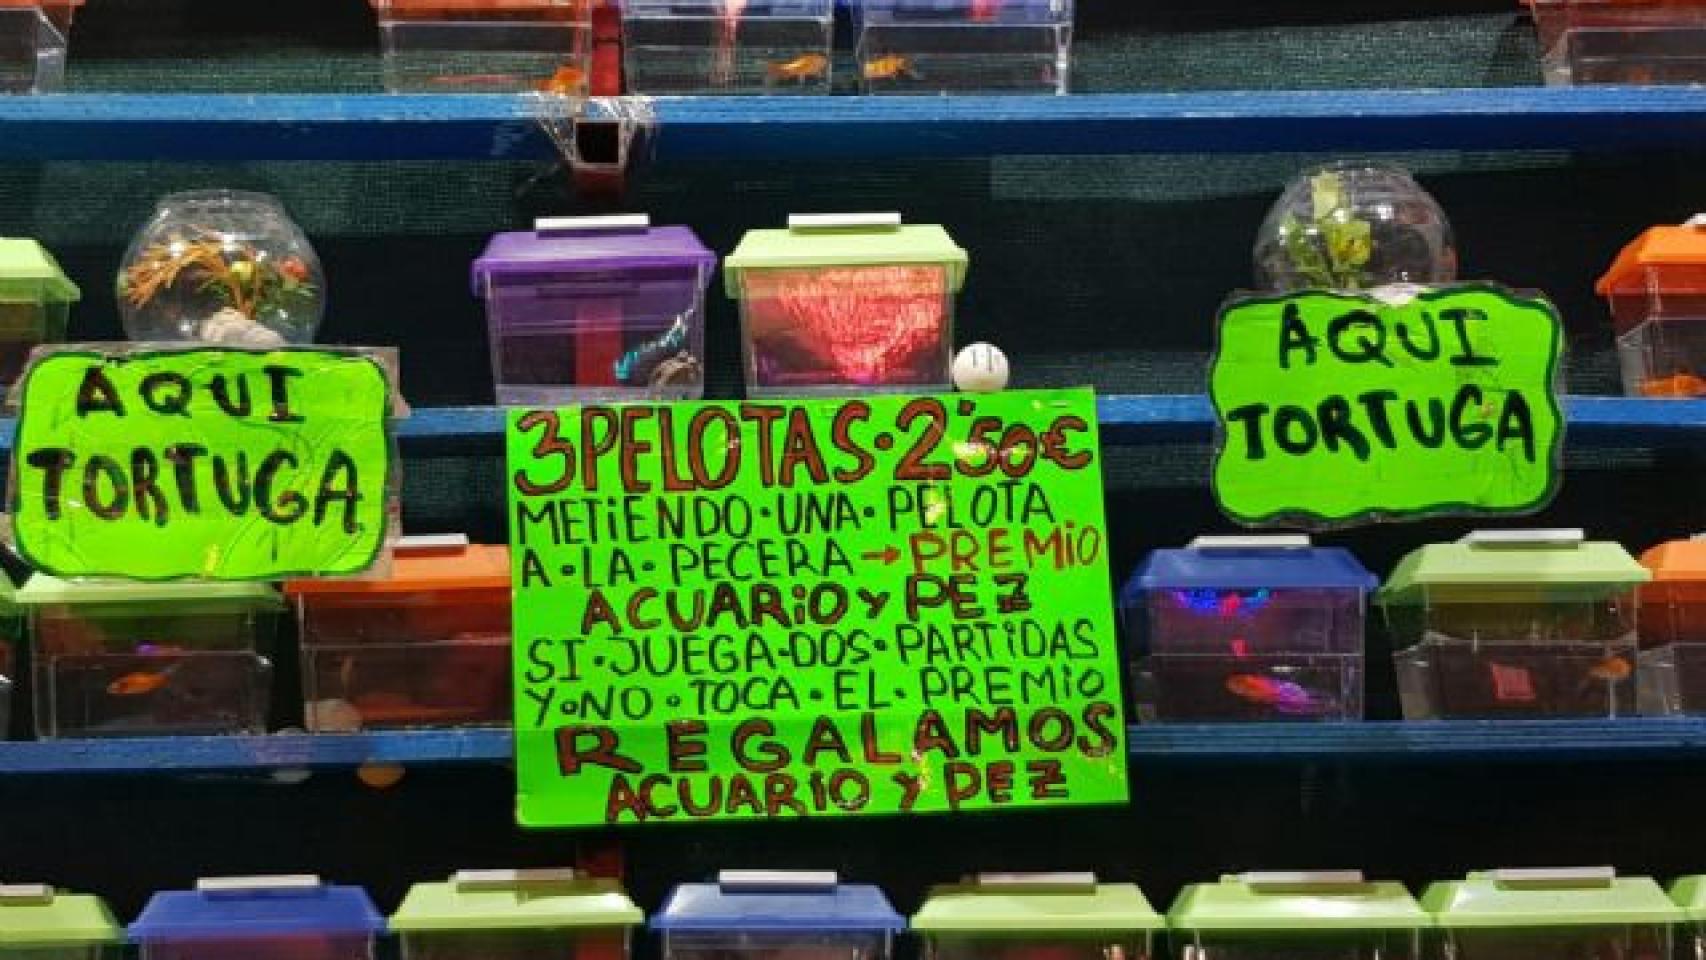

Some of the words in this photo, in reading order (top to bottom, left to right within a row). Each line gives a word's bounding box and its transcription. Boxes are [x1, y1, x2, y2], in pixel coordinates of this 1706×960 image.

[1279, 303, 1499, 369] AQUI
[75, 365, 305, 422] AQUI
[514, 409, 577, 496] 3
[580, 399, 875, 493] PELOTAS
[1226, 384, 1537, 464] TORTUGA
[26, 441, 364, 535] TORTUGA
[778, 490, 861, 535] UNA
[887, 479, 1056, 531] PELOTA
[521, 547, 552, 588] A
[582, 547, 636, 588] LA
[671, 537, 854, 586] PECERA
[905, 572, 1033, 622] PEZ
[524, 637, 586, 684] SI
[606, 631, 777, 678] JUEGA
[788, 628, 872, 669] DOS
[578, 684, 653, 722] NO
[687, 676, 802, 716] TOCA
[833, 668, 892, 710] EL
[554, 700, 1118, 777] REGALAMOS
[943, 759, 1069, 810] PEZ
